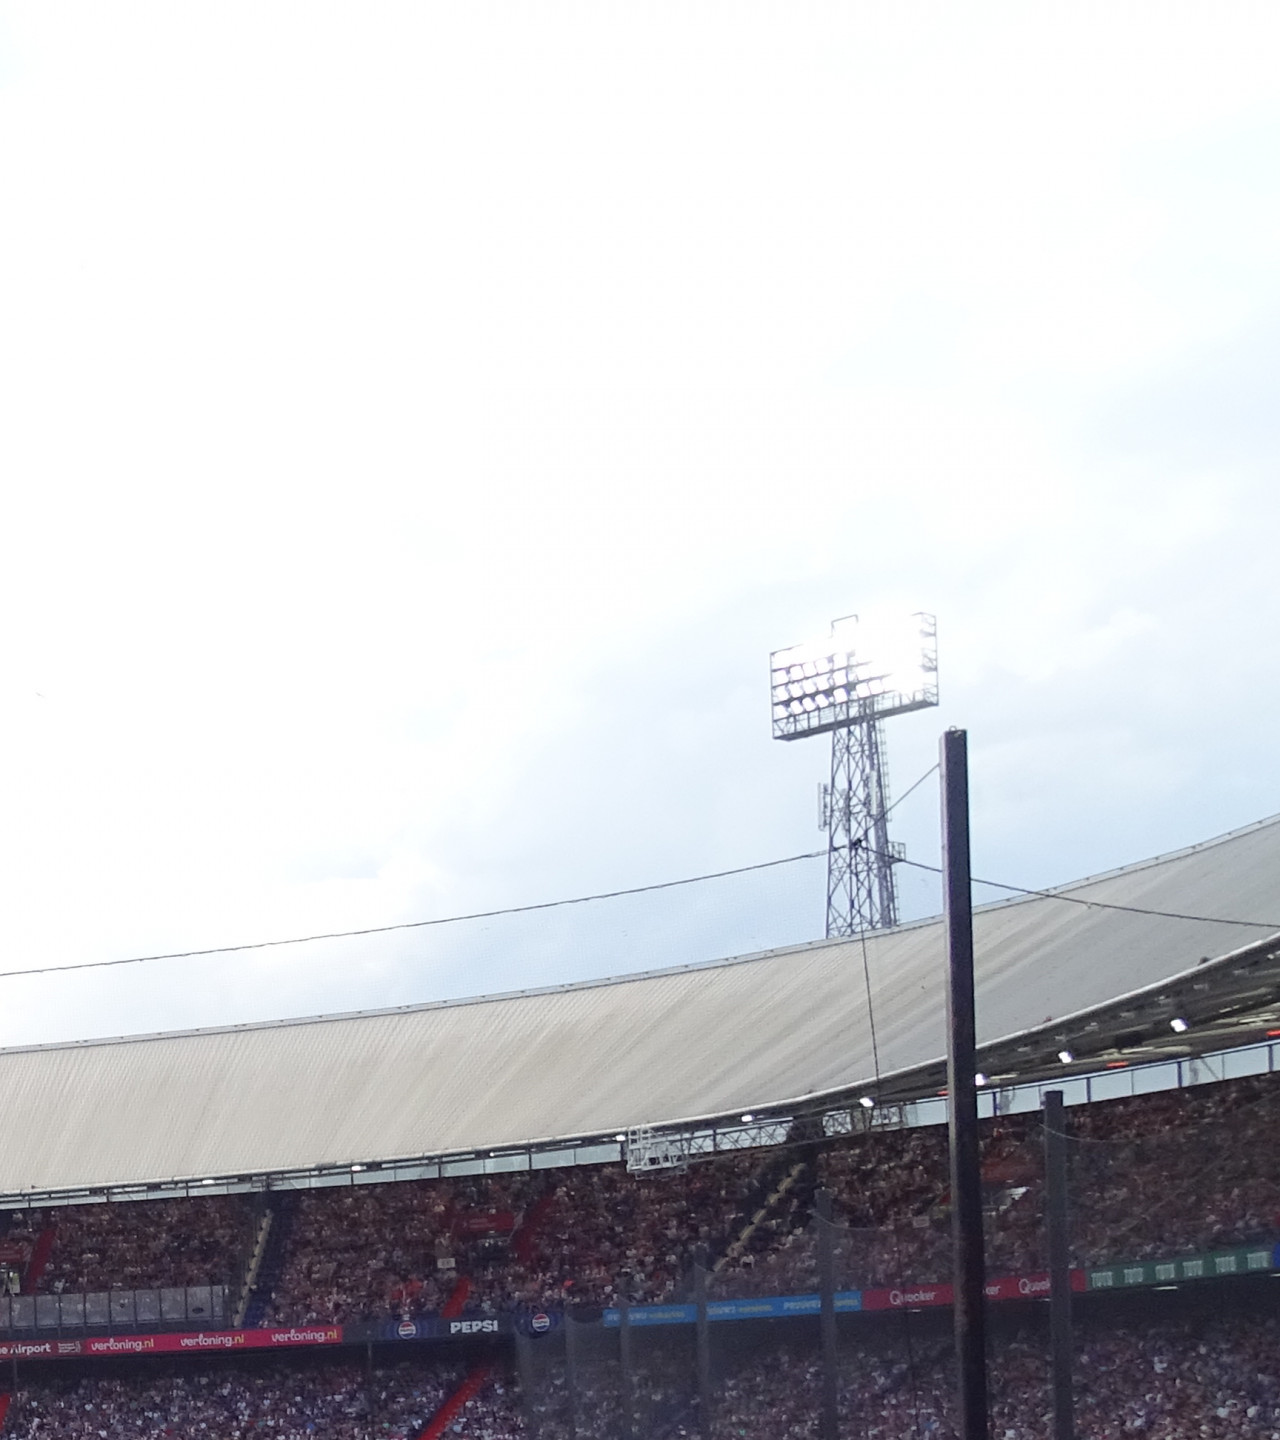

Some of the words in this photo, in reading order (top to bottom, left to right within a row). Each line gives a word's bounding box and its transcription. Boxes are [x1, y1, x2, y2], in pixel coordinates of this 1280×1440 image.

[450, 1319, 499, 1334] PEPSI
[180, 1333, 245, 1348] verloning.nl
[272, 1328, 338, 1343] verloning.nl
[91, 1337, 155, 1352] verloning.nl
